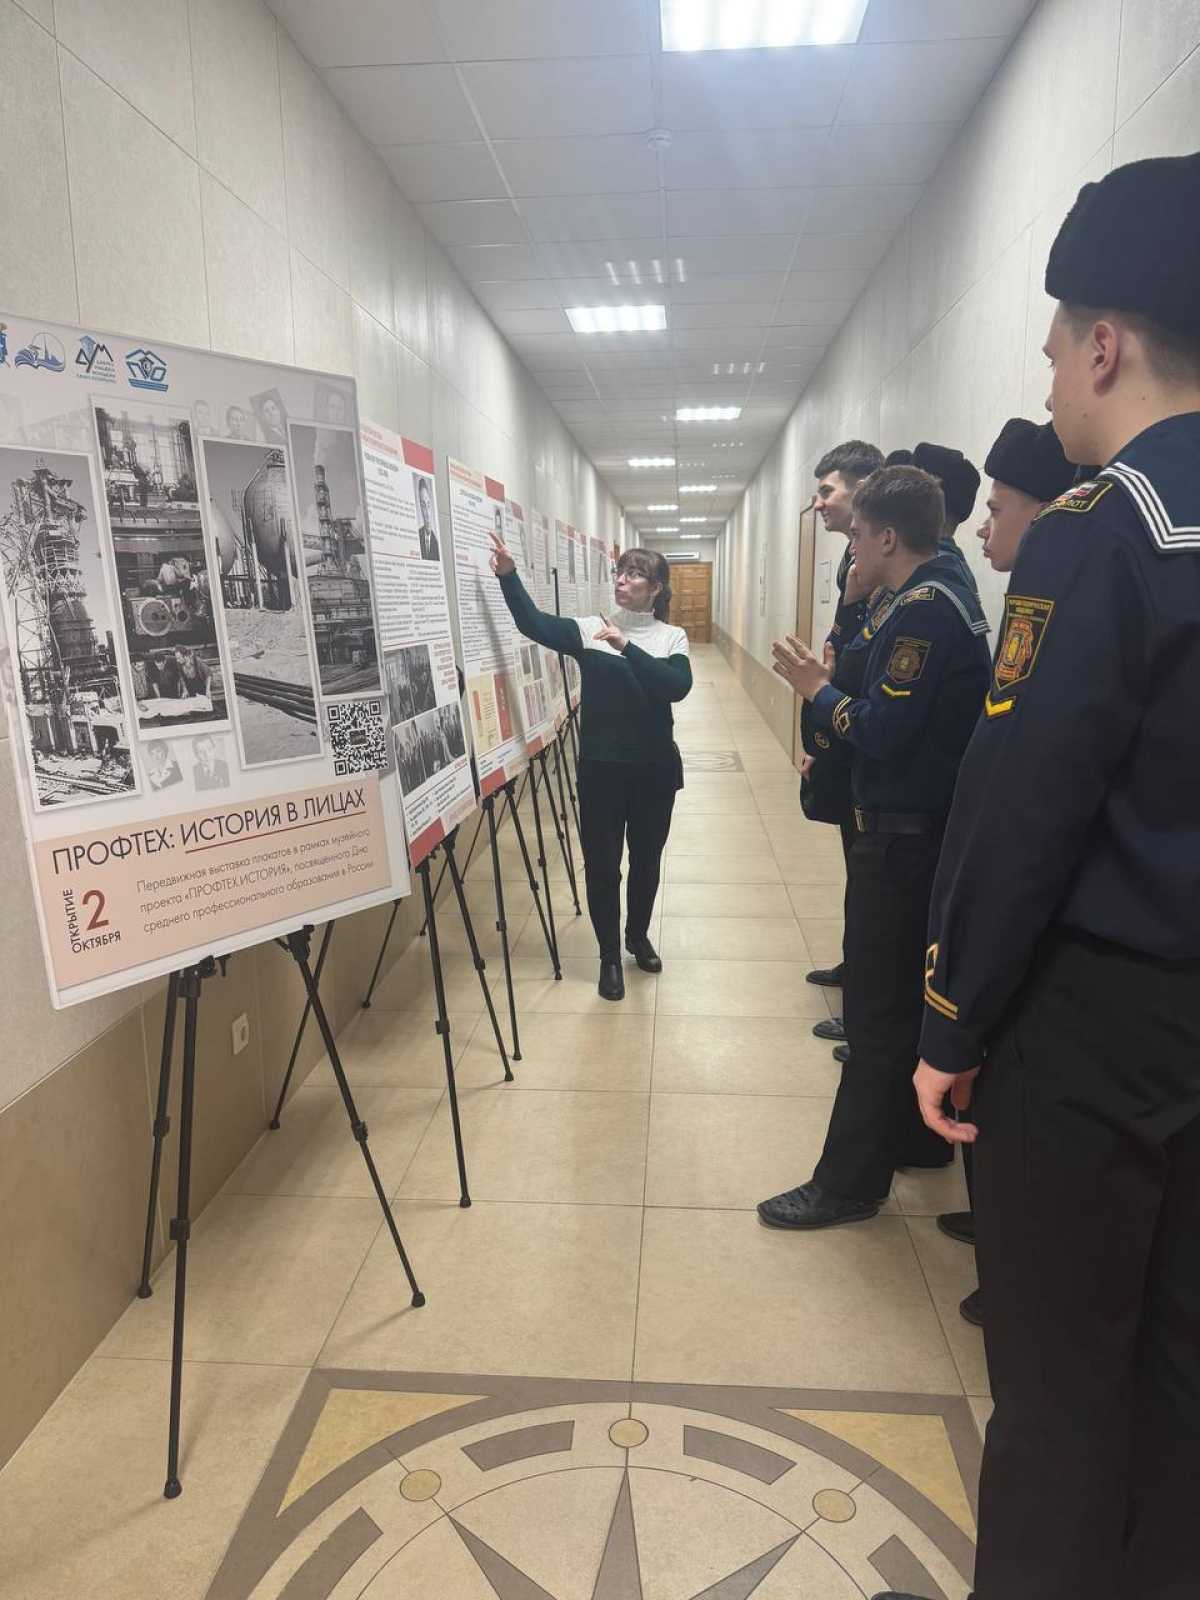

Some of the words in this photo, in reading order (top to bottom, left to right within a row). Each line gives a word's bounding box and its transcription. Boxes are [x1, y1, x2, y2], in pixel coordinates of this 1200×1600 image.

[53, 827, 175, 874] ПРОФТЕХ:
[180, 804, 281, 846] ИСТОРИЯ
[286, 802, 298, 822] В
[303, 788, 366, 819] ЛИЦАХ
[136, 869, 206, 894] Передвижная
[208, 858, 250, 875] выставка
[252, 847, 292, 863] плакатов
[300, 839, 329, 855] рамках
[63, 889, 82, 953] ОТКРЫТИЕ
[82, 890, 109, 931] 2
[140, 894, 183, 914] проекта
[143, 911, 190, 934] среднего
[193, 886, 284, 921] профессионального
[287, 870, 340, 891] образования
[348, 861, 374, 873] России
[72, 931, 121, 953] ОКТЯБРЯ
